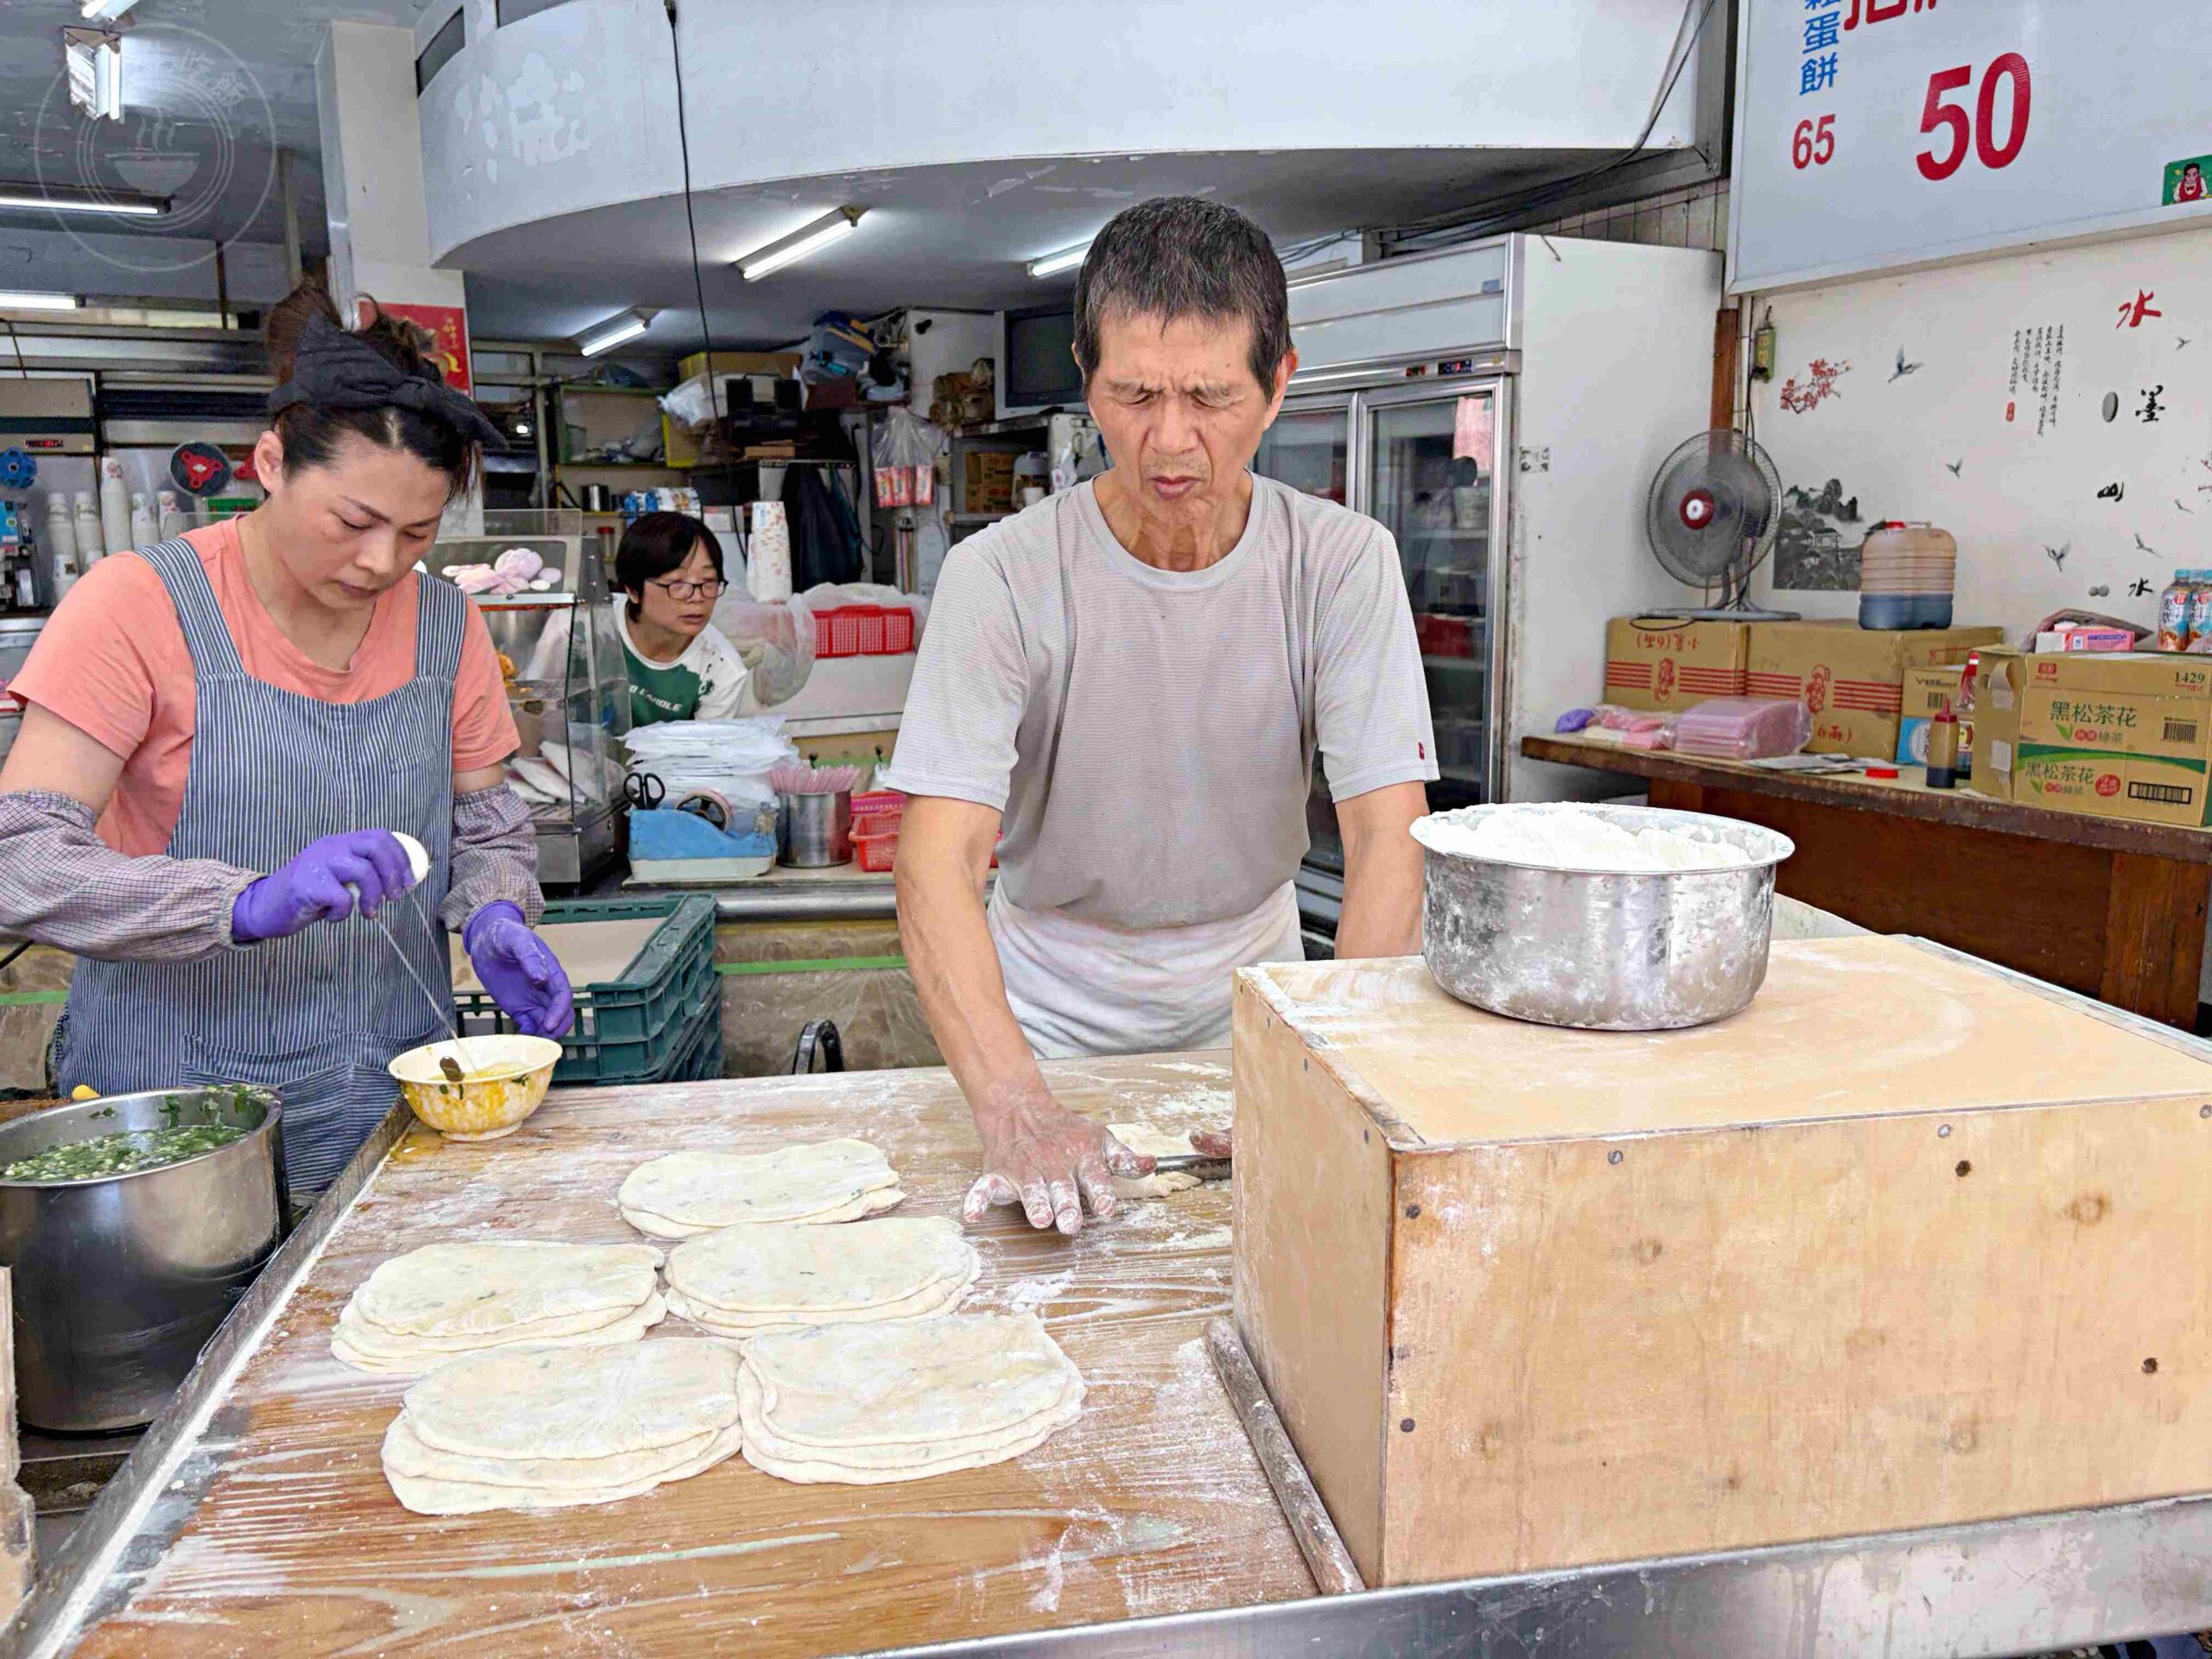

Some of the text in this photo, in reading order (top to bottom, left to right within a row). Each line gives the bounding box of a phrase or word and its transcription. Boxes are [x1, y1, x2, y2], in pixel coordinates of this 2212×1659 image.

[1799, 0, 1840, 96] 蛋餅
[1916, 52, 2031, 181] 50
[1792, 113, 1836, 169] 65
[2116, 289, 2162, 329] 水
[2128, 577, 2153, 596] 水
[2175, 671, 2205, 683] 1429
[2050, 701, 2138, 728] 黑松茶花
[2025, 761, 2095, 785] 黑松茶花
